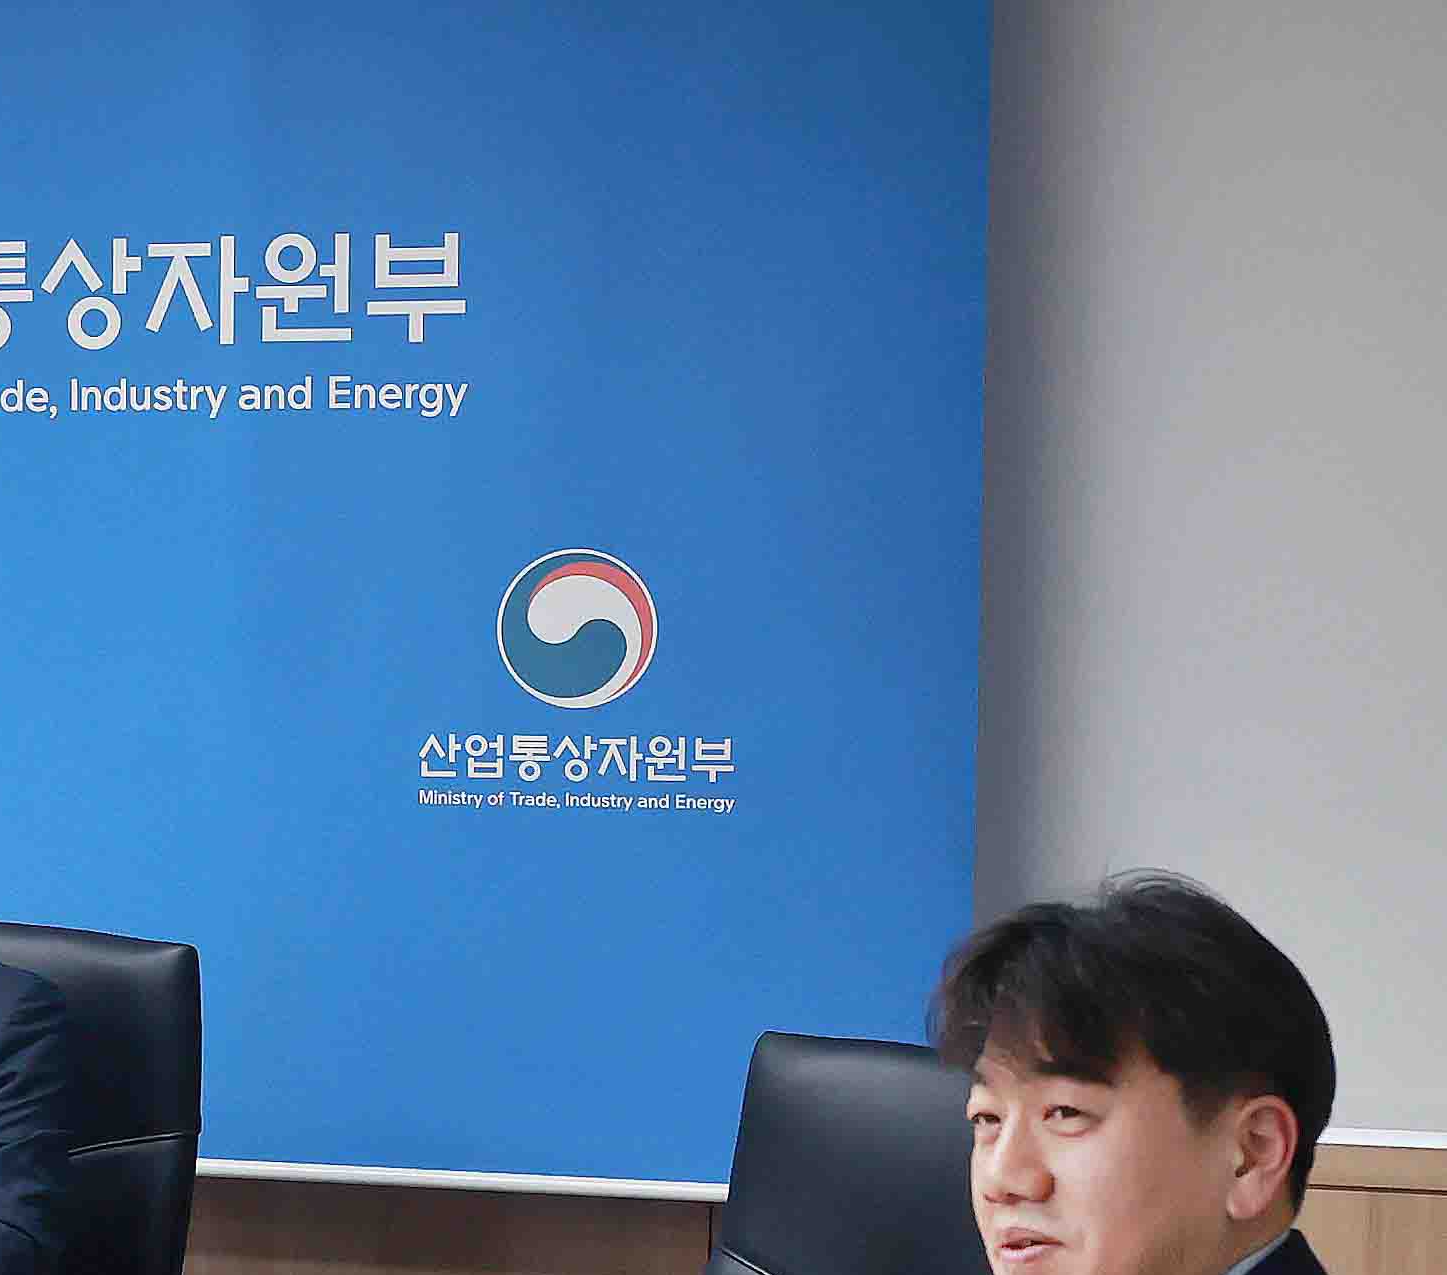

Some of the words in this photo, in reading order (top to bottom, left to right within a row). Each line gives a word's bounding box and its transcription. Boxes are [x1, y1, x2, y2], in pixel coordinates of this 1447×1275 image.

[71, 378, 227, 419] Industry
[238, 375, 312, 411] and
[328, 375, 469, 418] Energy
[418, 733, 735, 783] 산업통상자원부
[419, 789, 484, 809] Ministry
[487, 791, 505, 806] of
[509, 791, 561, 809] Trade,
[565, 792, 634, 811] Industry
[637, 793, 670, 809] and
[675, 794, 735, 814] Energy
